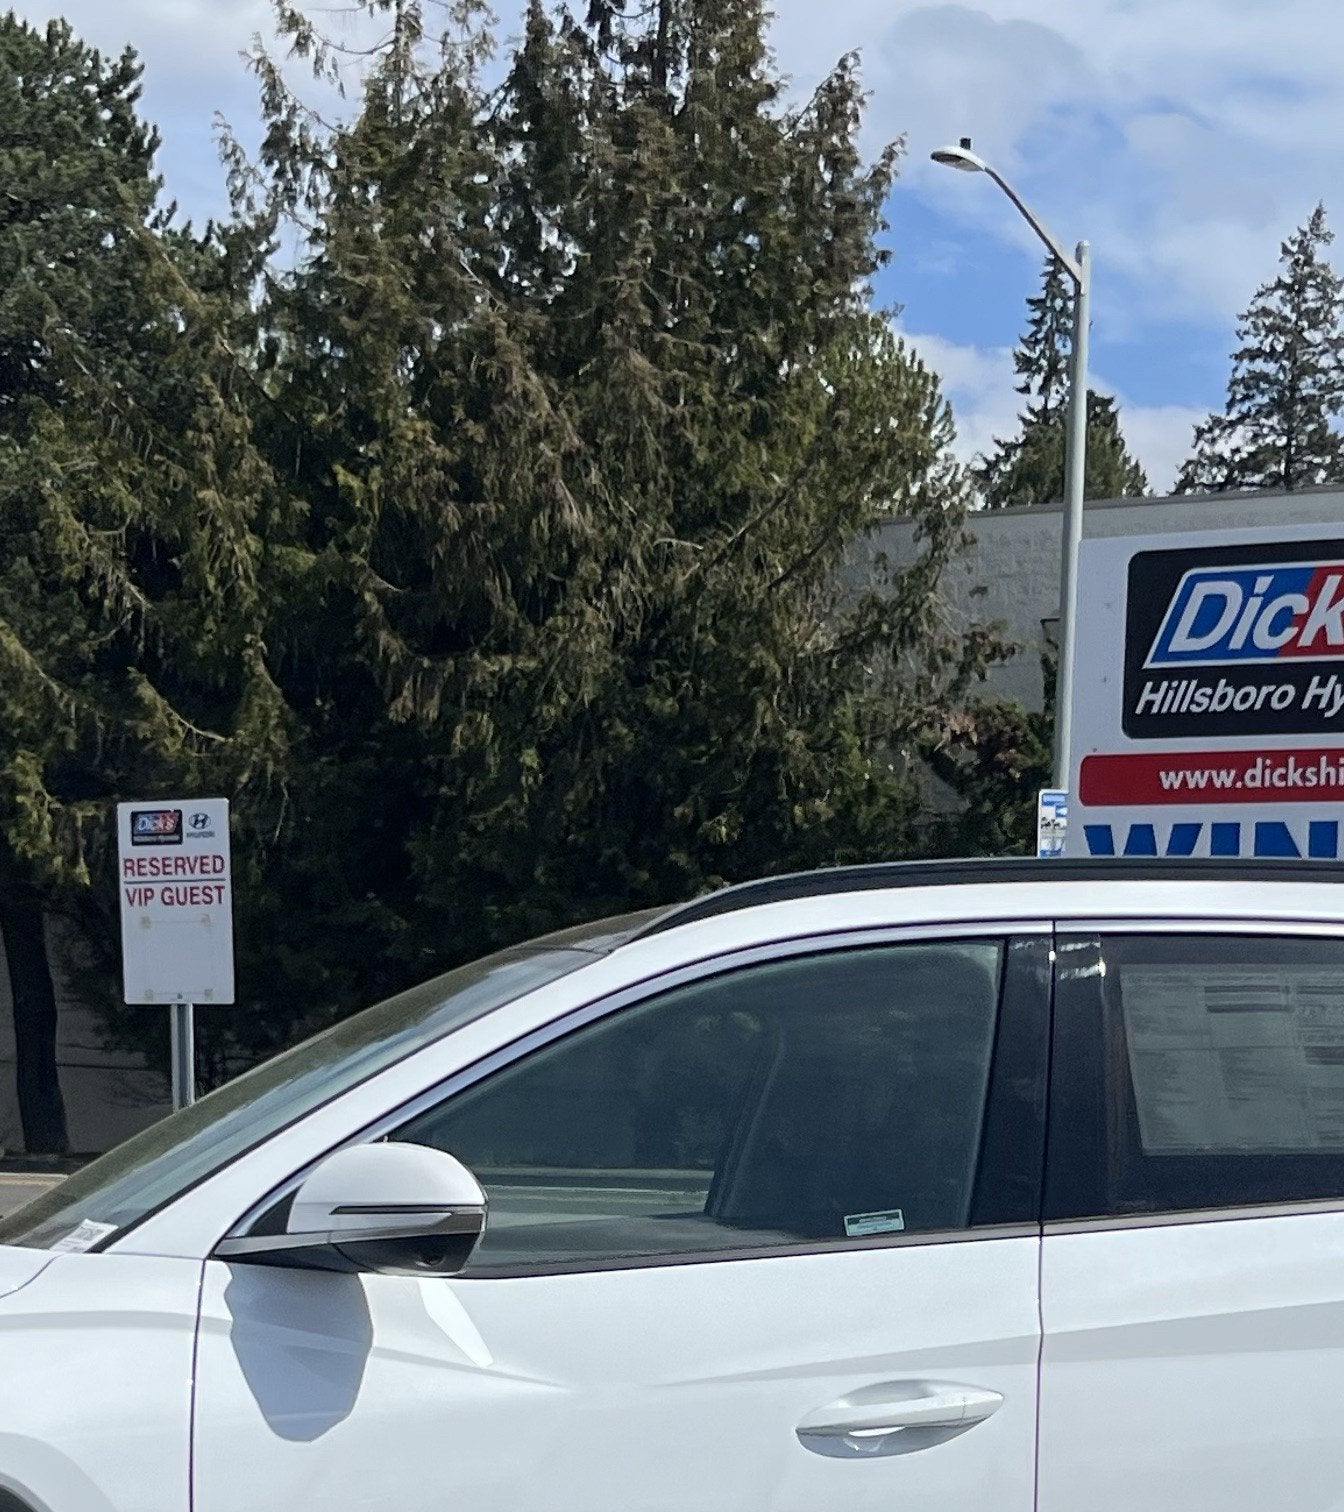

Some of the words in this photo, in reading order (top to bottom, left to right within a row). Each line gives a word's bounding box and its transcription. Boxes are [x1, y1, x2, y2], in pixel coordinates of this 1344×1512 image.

[1135, 678, 1296, 715] Hillsboro
[123, 855, 225, 878] RESERVED
[125, 887, 155, 907] VIP
[160, 885, 226, 906] GUEST
